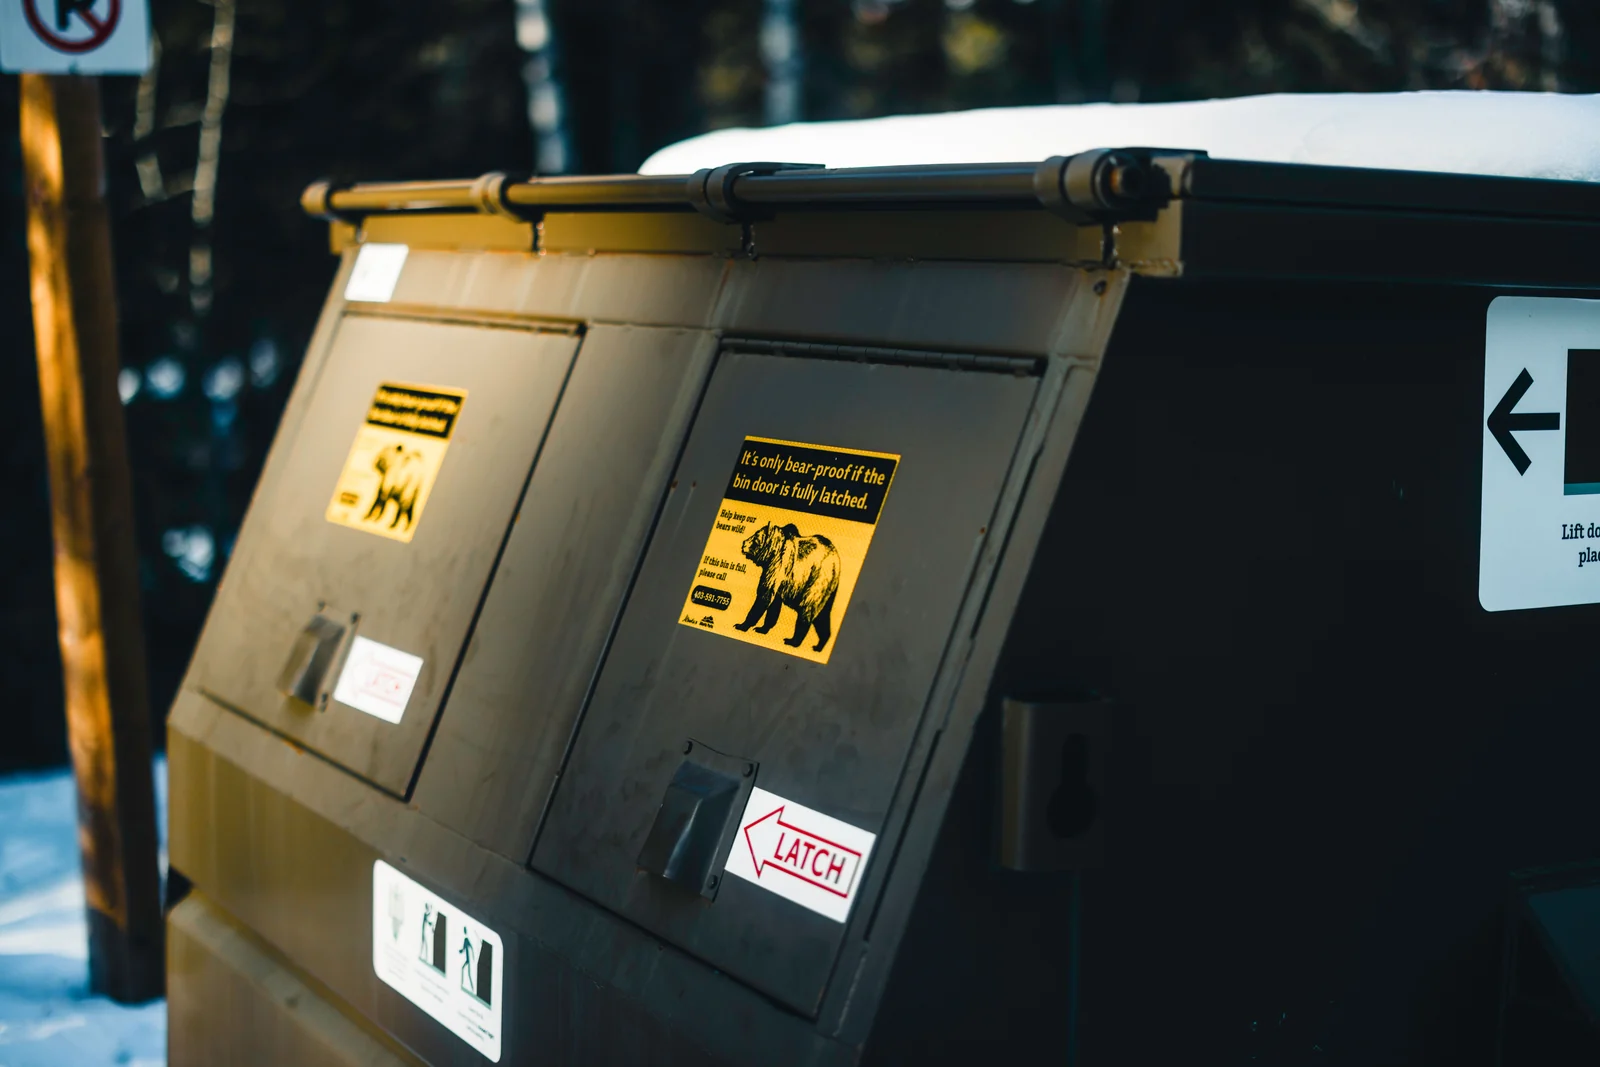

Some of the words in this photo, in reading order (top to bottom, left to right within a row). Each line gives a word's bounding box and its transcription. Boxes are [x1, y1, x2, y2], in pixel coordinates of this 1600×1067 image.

[740, 450, 758, 467] It's
[759, 455, 784, 475] only
[784, 456, 852, 481] bear-proof
[852, 465, 864, 482] if
[864, 468, 885, 485] the
[732, 473, 750, 489] bin
[751, 477, 779, 494] door
[780, 481, 790, 496] is
[791, 482, 818, 505] fully
[819, 486, 868, 510] latched.
[720, 509, 733, 521] Help
[733, 511, 747, 523] keep
[746, 516, 757, 524] our
[716, 521, 731, 531] bears
[731, 524, 745, 533] wild!
[1562, 523, 1584, 540] Lift
[703, 556, 709, 564] If
[709, 557, 720, 567] this
[720, 559, 730, 569] bin
[730, 562, 735, 570] is
[735, 563, 747, 574] full,
[698, 568, 716, 578] please
[716, 571, 727, 581] call
[773, 832, 847, 885] LATCH
